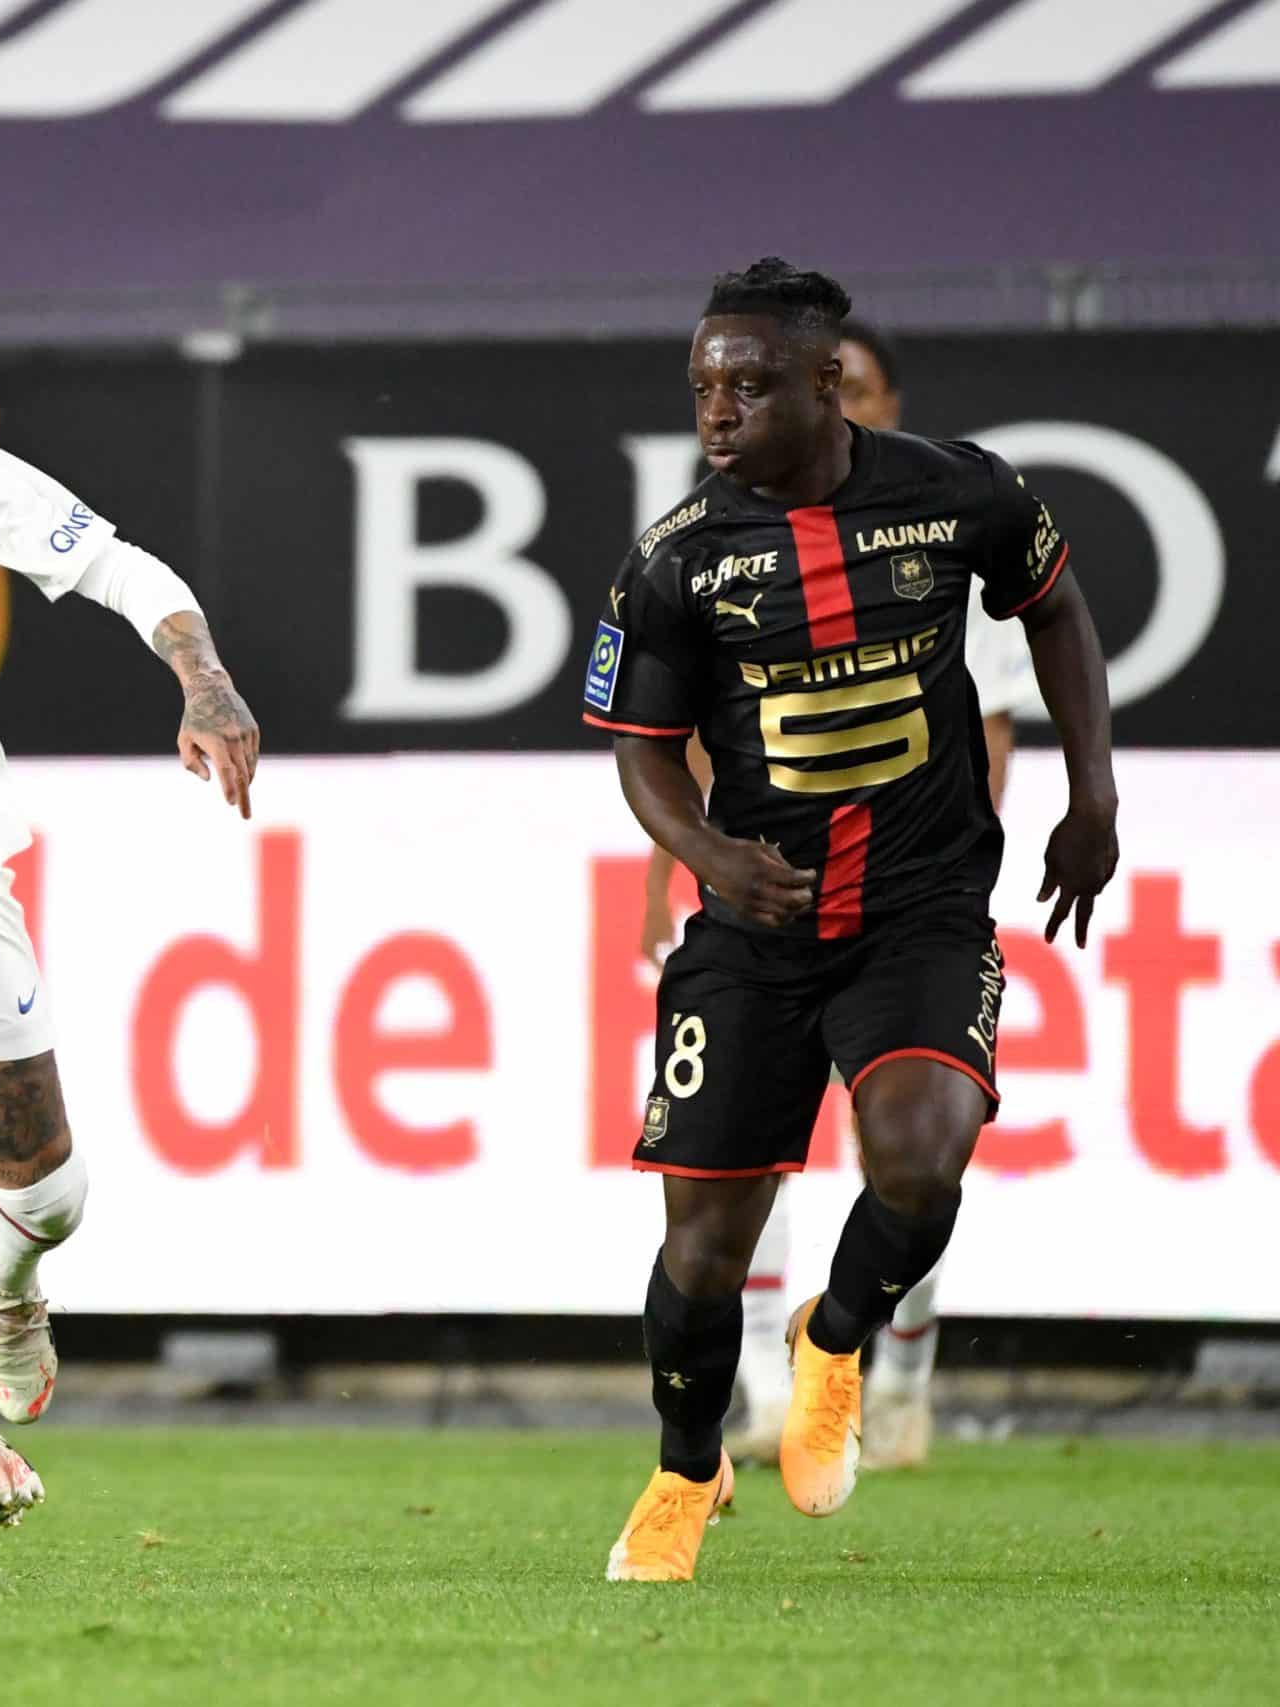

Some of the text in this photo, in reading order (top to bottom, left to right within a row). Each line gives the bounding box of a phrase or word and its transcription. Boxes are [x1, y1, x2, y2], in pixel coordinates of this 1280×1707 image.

[856, 519, 958, 553] LAUNAY
[738, 627, 939, 689] SAMSIC
[128, 824, 494, 1180] de
